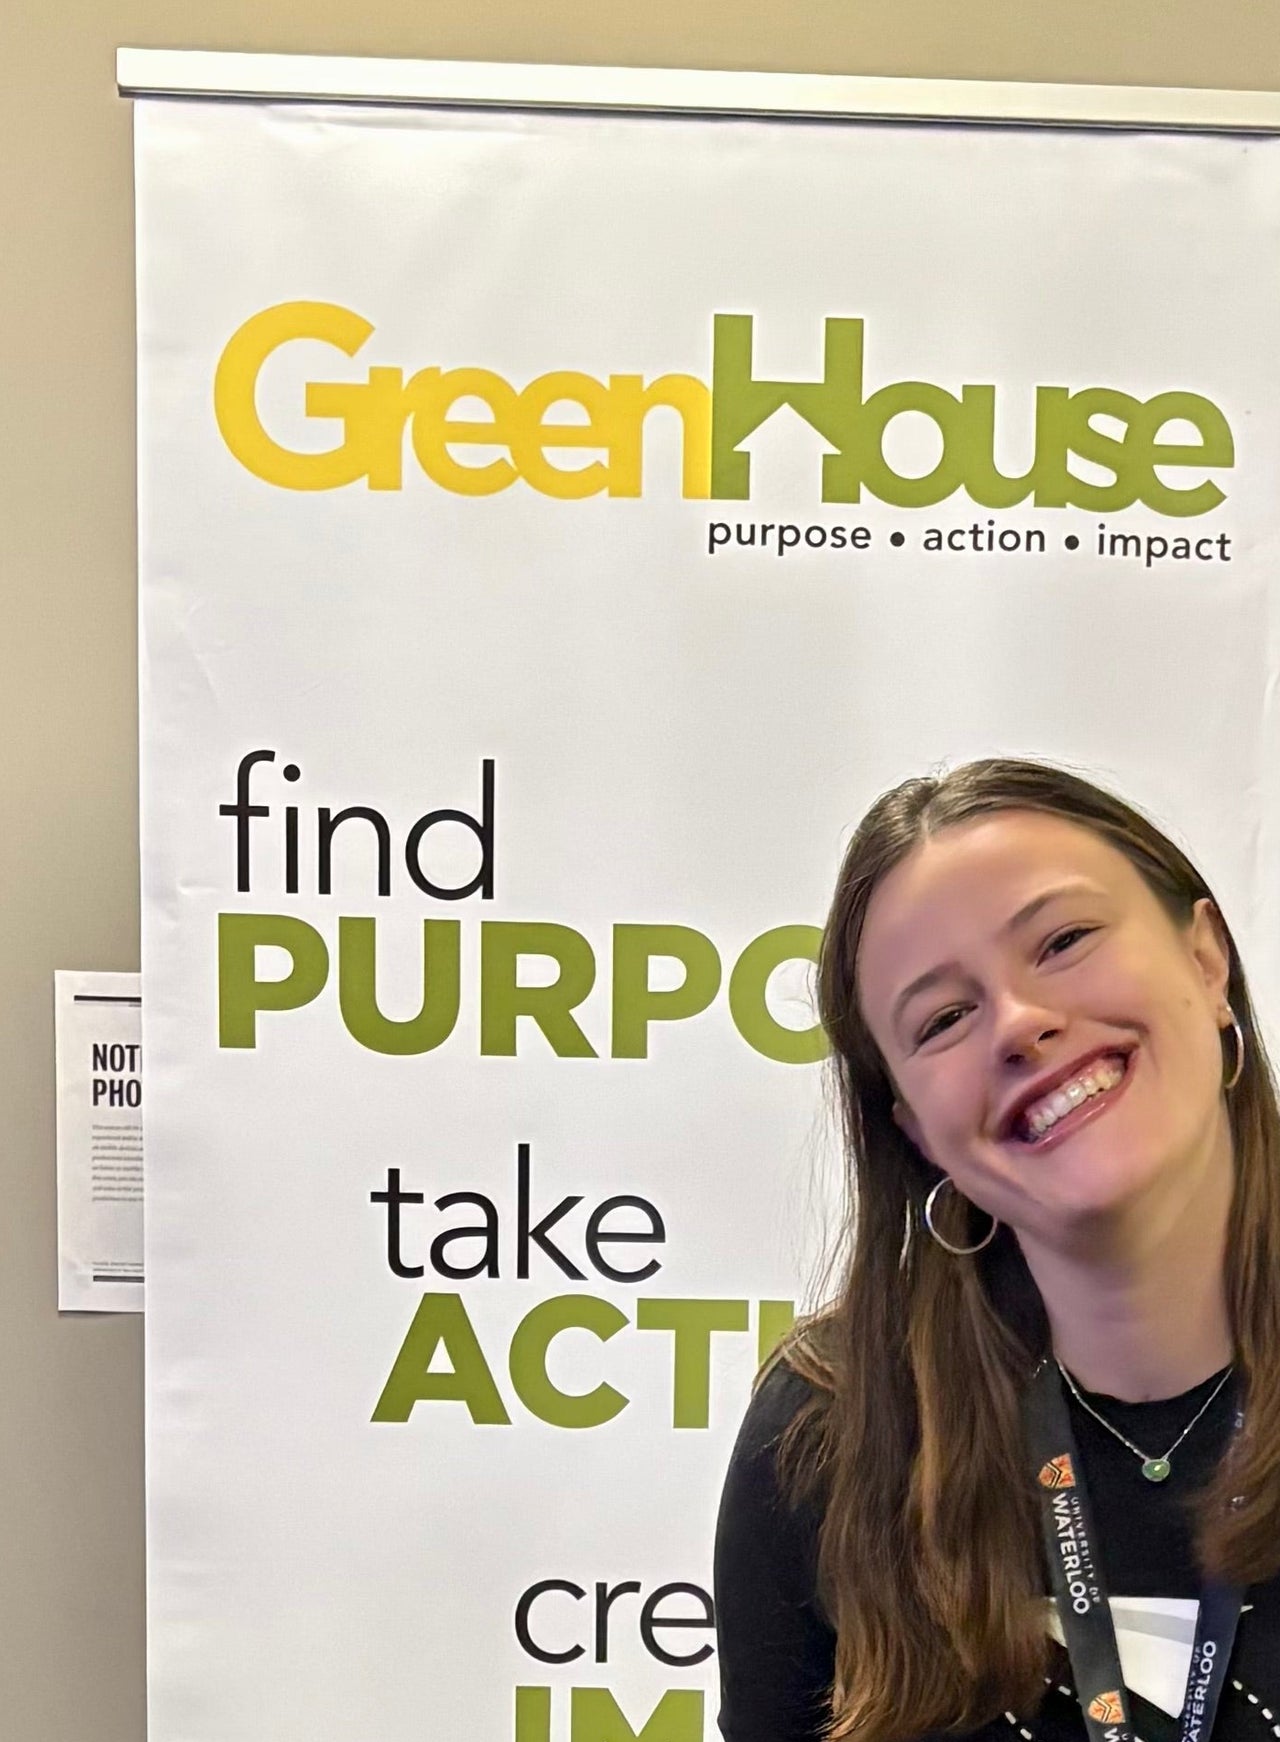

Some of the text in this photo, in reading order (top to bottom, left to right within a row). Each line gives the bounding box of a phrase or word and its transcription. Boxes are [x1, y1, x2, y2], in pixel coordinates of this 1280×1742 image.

[213, 298, 1236, 518] GreenHouse
[707, 520, 1233, 564] purpose action impact
[218, 750, 497, 902] find
[91, 1043, 142, 1072] NOT
[370, 1143, 667, 1283] take
[1052, 1492, 1090, 1615] WATERLOO
[514, 1579, 716, 1665] cre
